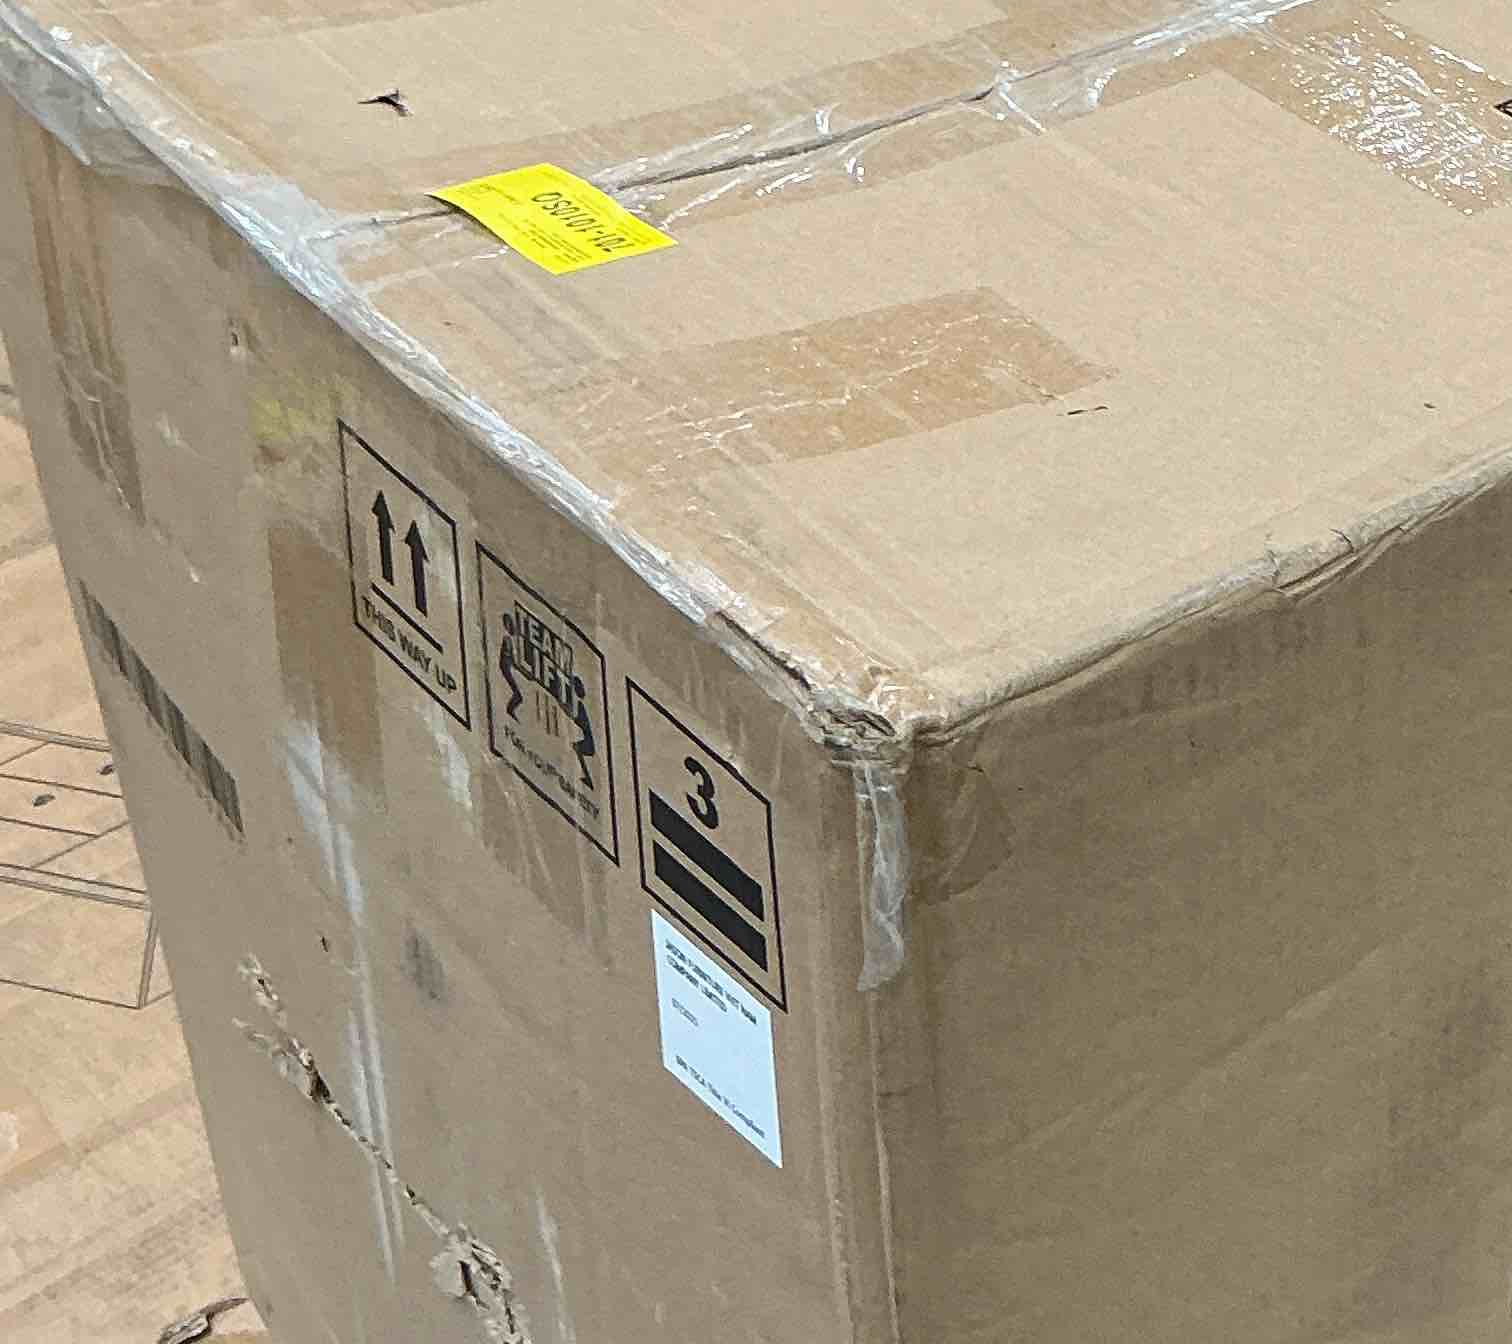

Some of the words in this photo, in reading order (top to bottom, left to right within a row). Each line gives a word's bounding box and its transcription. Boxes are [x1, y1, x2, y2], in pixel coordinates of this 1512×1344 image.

[361, 595, 397, 642] THIS
[397, 631, 432, 673] WAY
[434, 664, 457, 691] UP
[684, 756, 719, 830] 3
